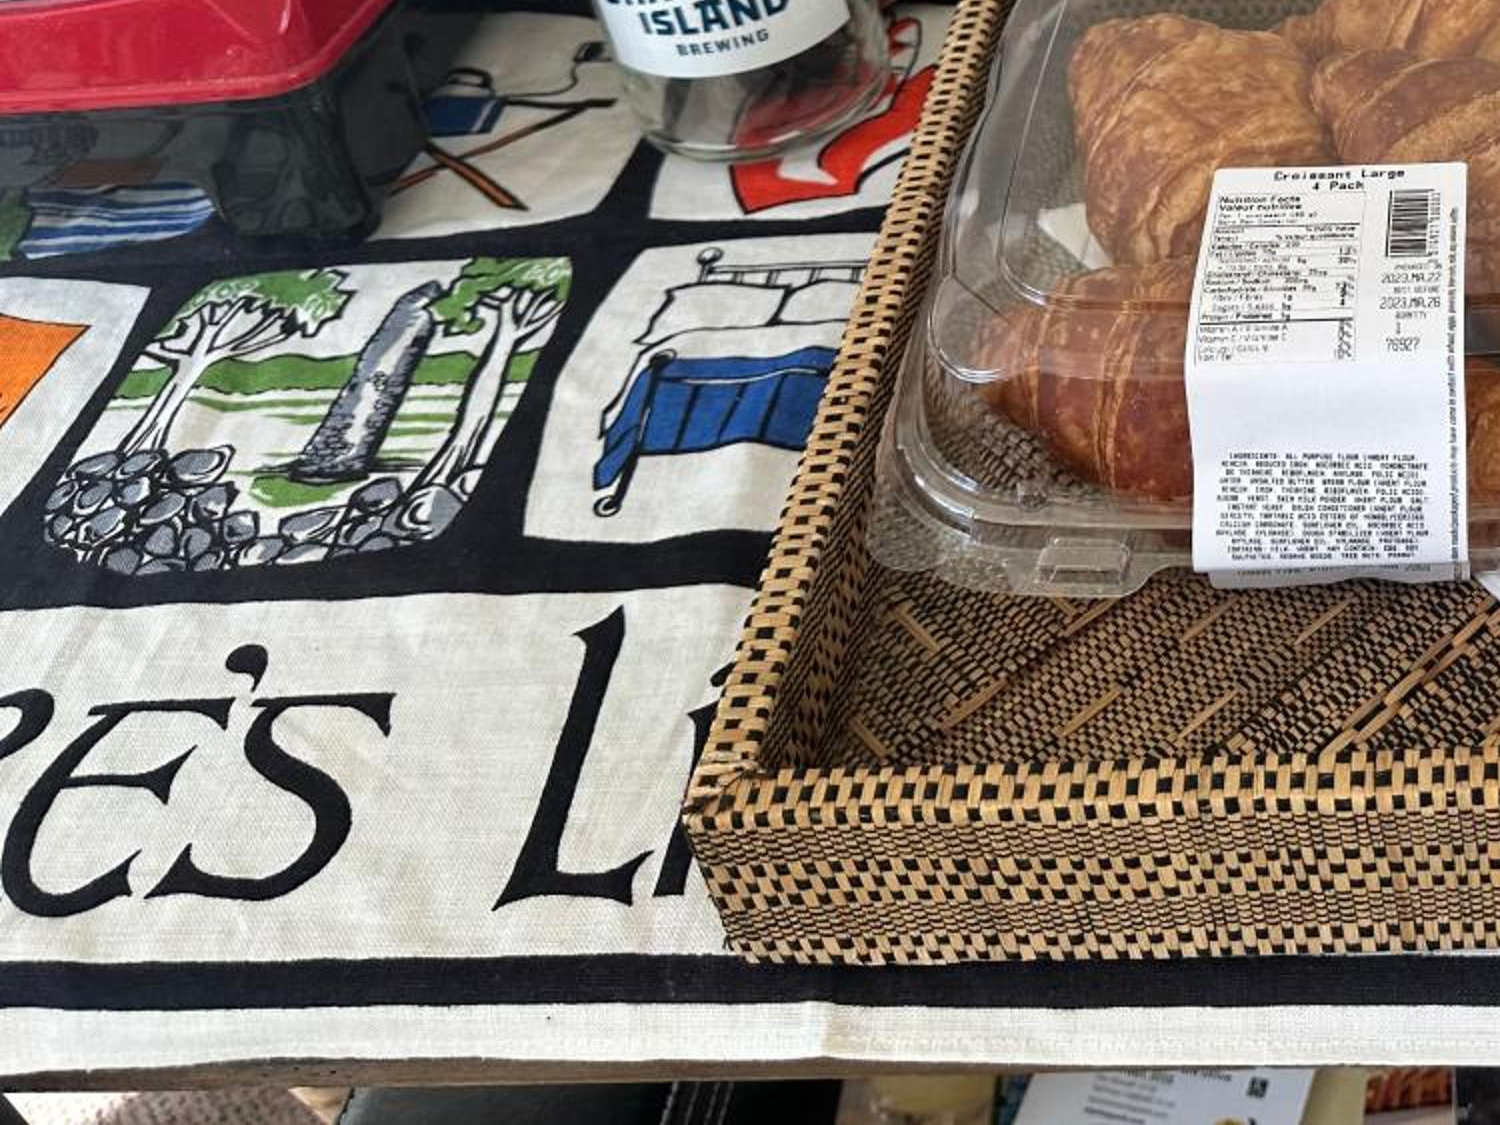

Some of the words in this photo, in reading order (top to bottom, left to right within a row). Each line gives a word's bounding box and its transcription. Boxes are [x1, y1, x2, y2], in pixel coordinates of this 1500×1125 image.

[675, 28, 770, 58] BREWING
[1273, 170, 1352, 182] Croissant
[1361, 168, 1405, 181] Large
[1312, 182, 1320, 191] 4
[1329, 180, 1366, 191] Pack
